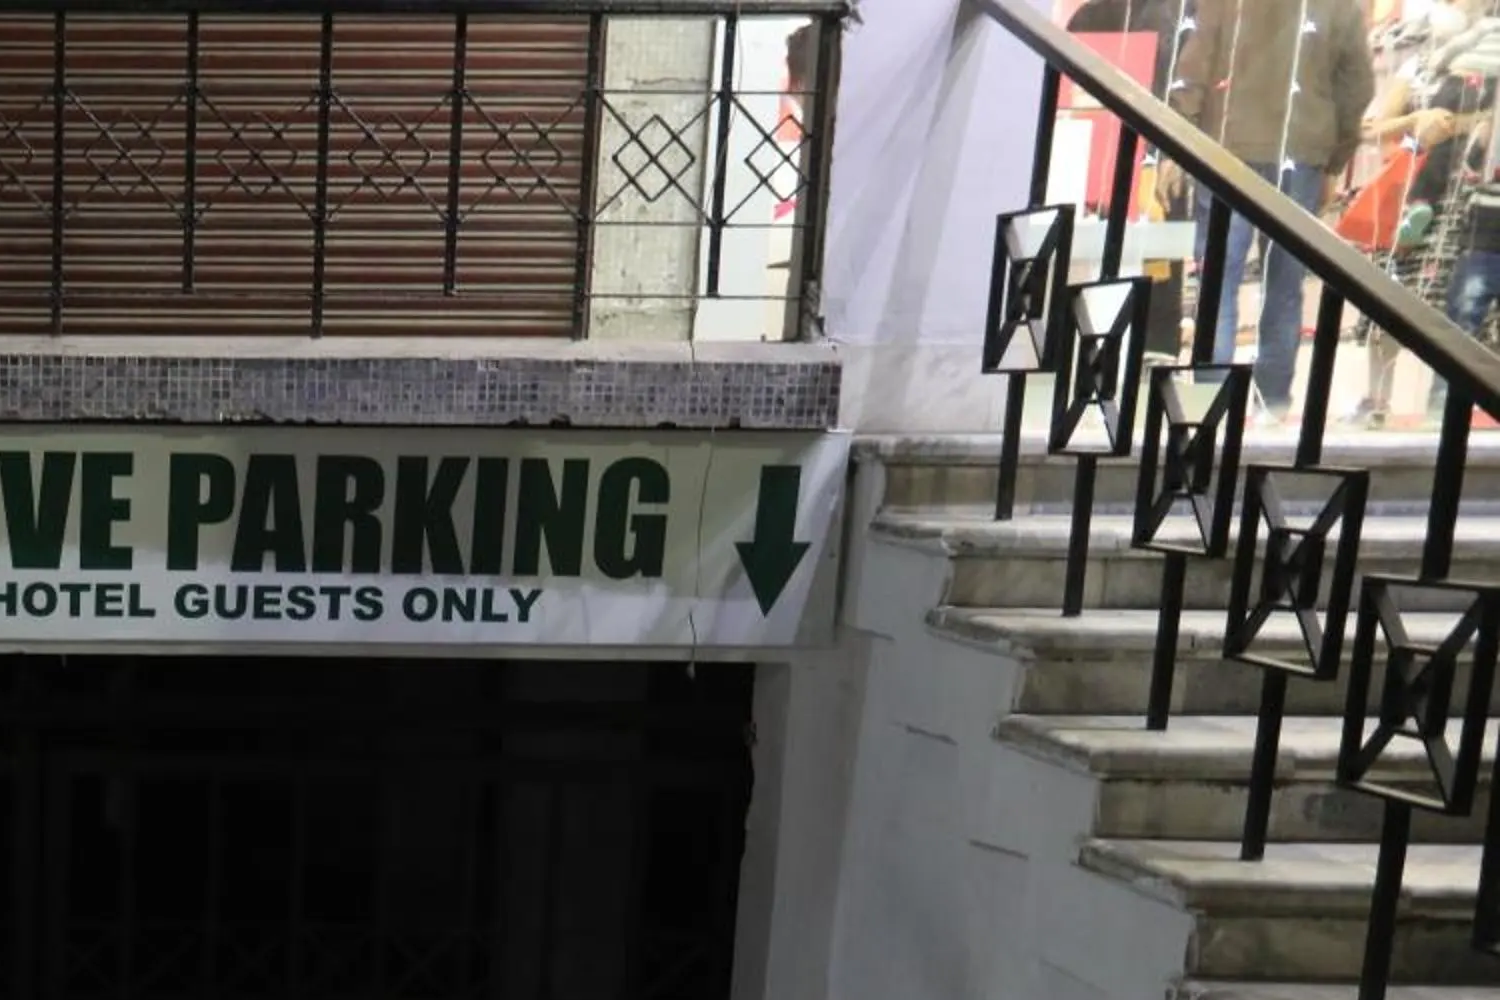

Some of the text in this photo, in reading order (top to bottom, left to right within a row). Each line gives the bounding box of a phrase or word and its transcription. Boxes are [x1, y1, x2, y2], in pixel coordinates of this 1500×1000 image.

[167, 453, 671, 580] PARKING
[175, 584, 384, 621] GUESTS
[403, 587, 543, 623] ONLY
